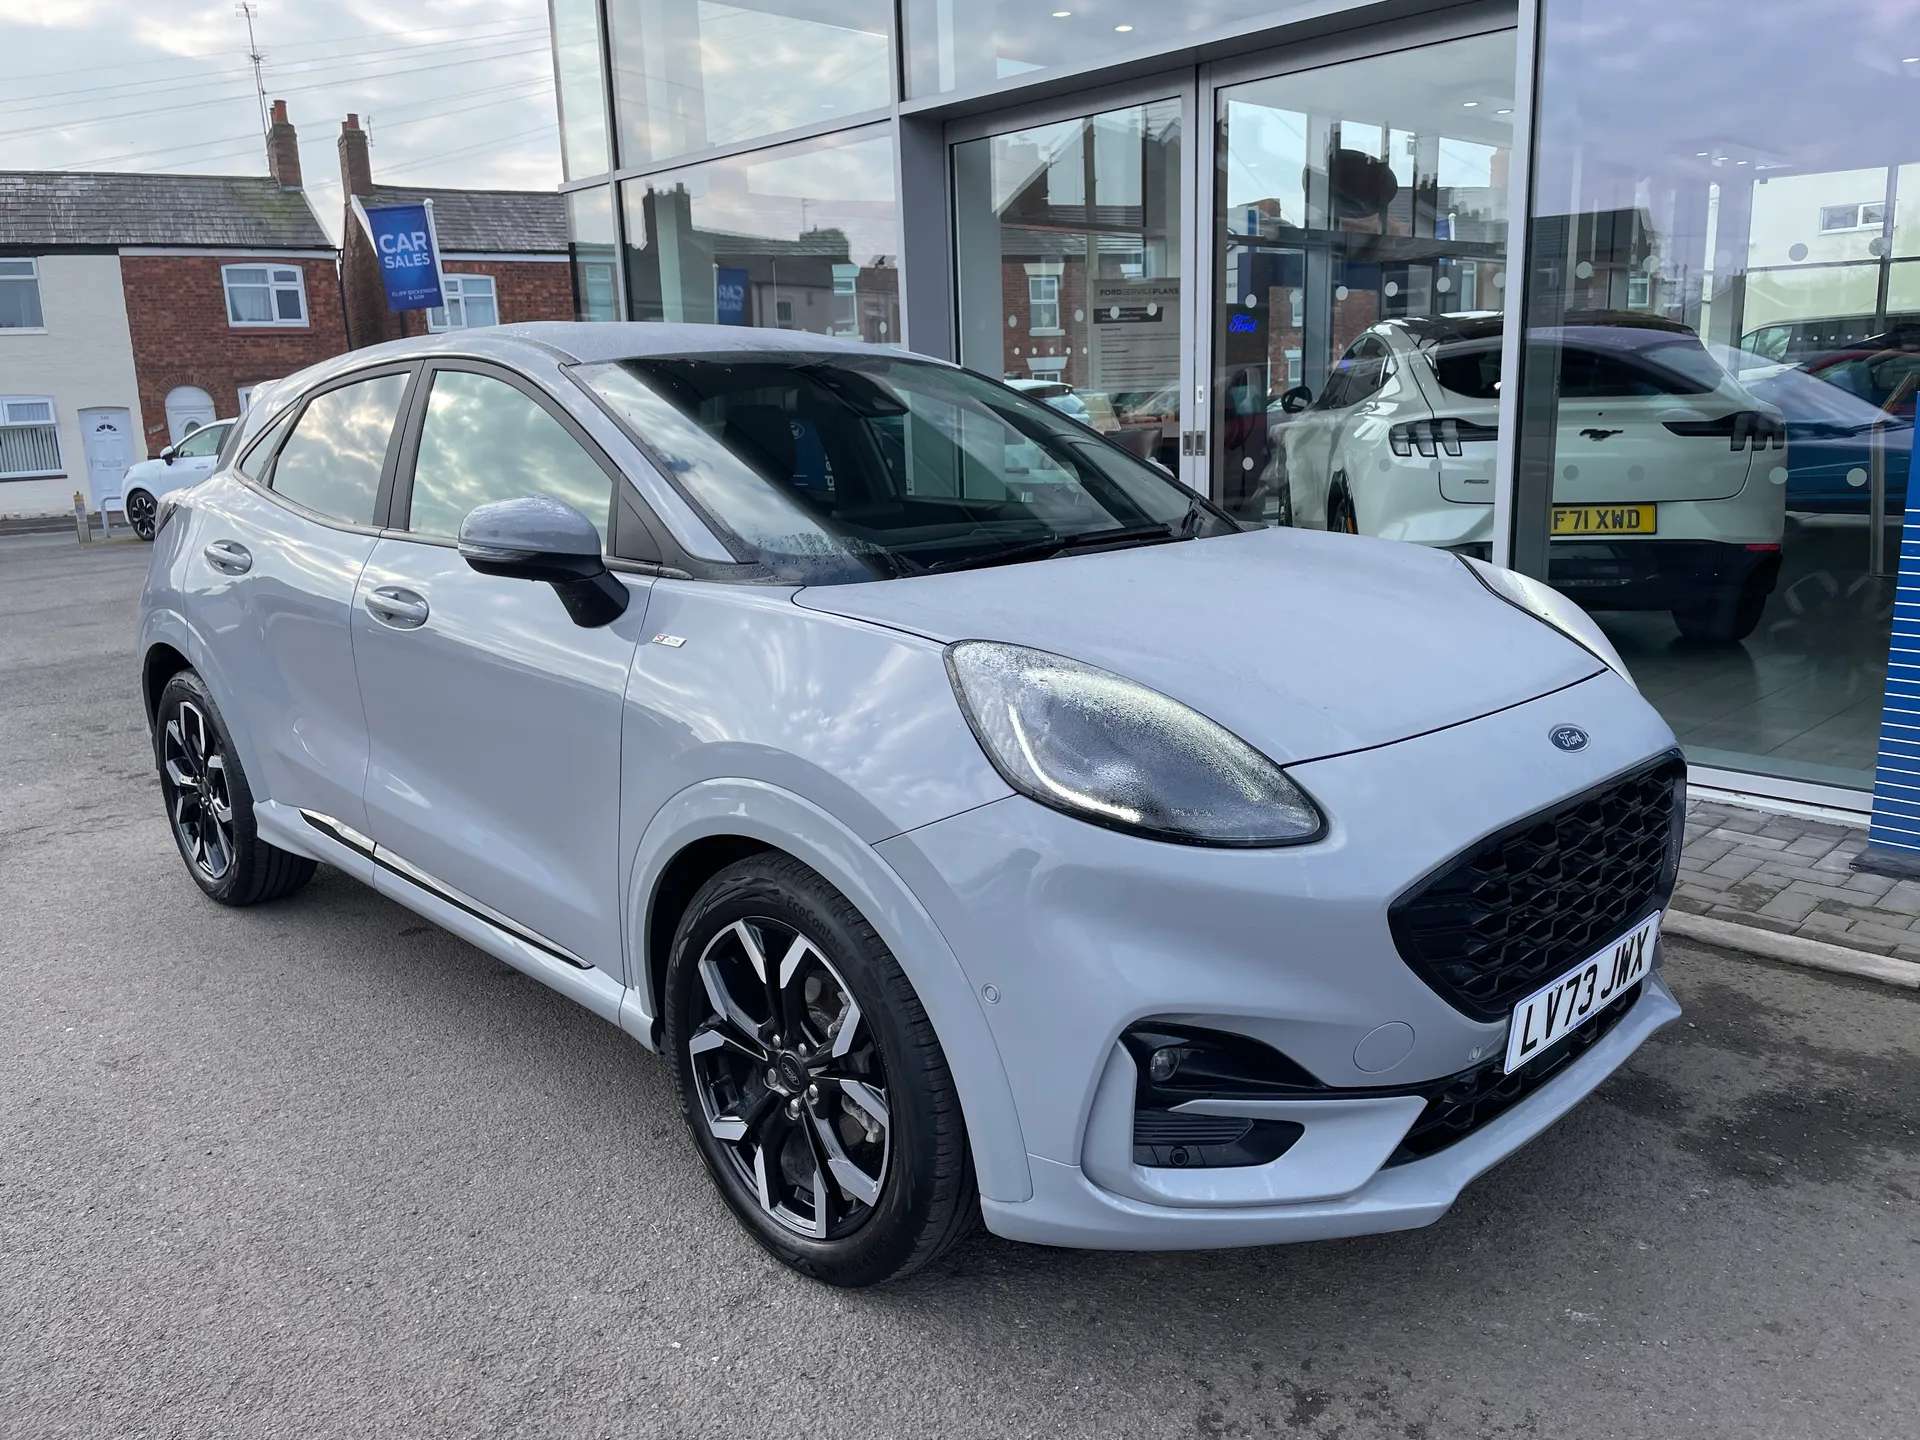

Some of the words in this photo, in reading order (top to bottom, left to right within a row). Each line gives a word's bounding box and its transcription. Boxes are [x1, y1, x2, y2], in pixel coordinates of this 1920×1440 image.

[379, 232, 428, 253] CAR
[384, 253, 431, 269] SALES
[1595, 508, 1641, 529] XWD
[1558, 730, 1584, 747] Ford
[1520, 963, 1598, 1057] LV73
[1600, 925, 1650, 999] JWX
